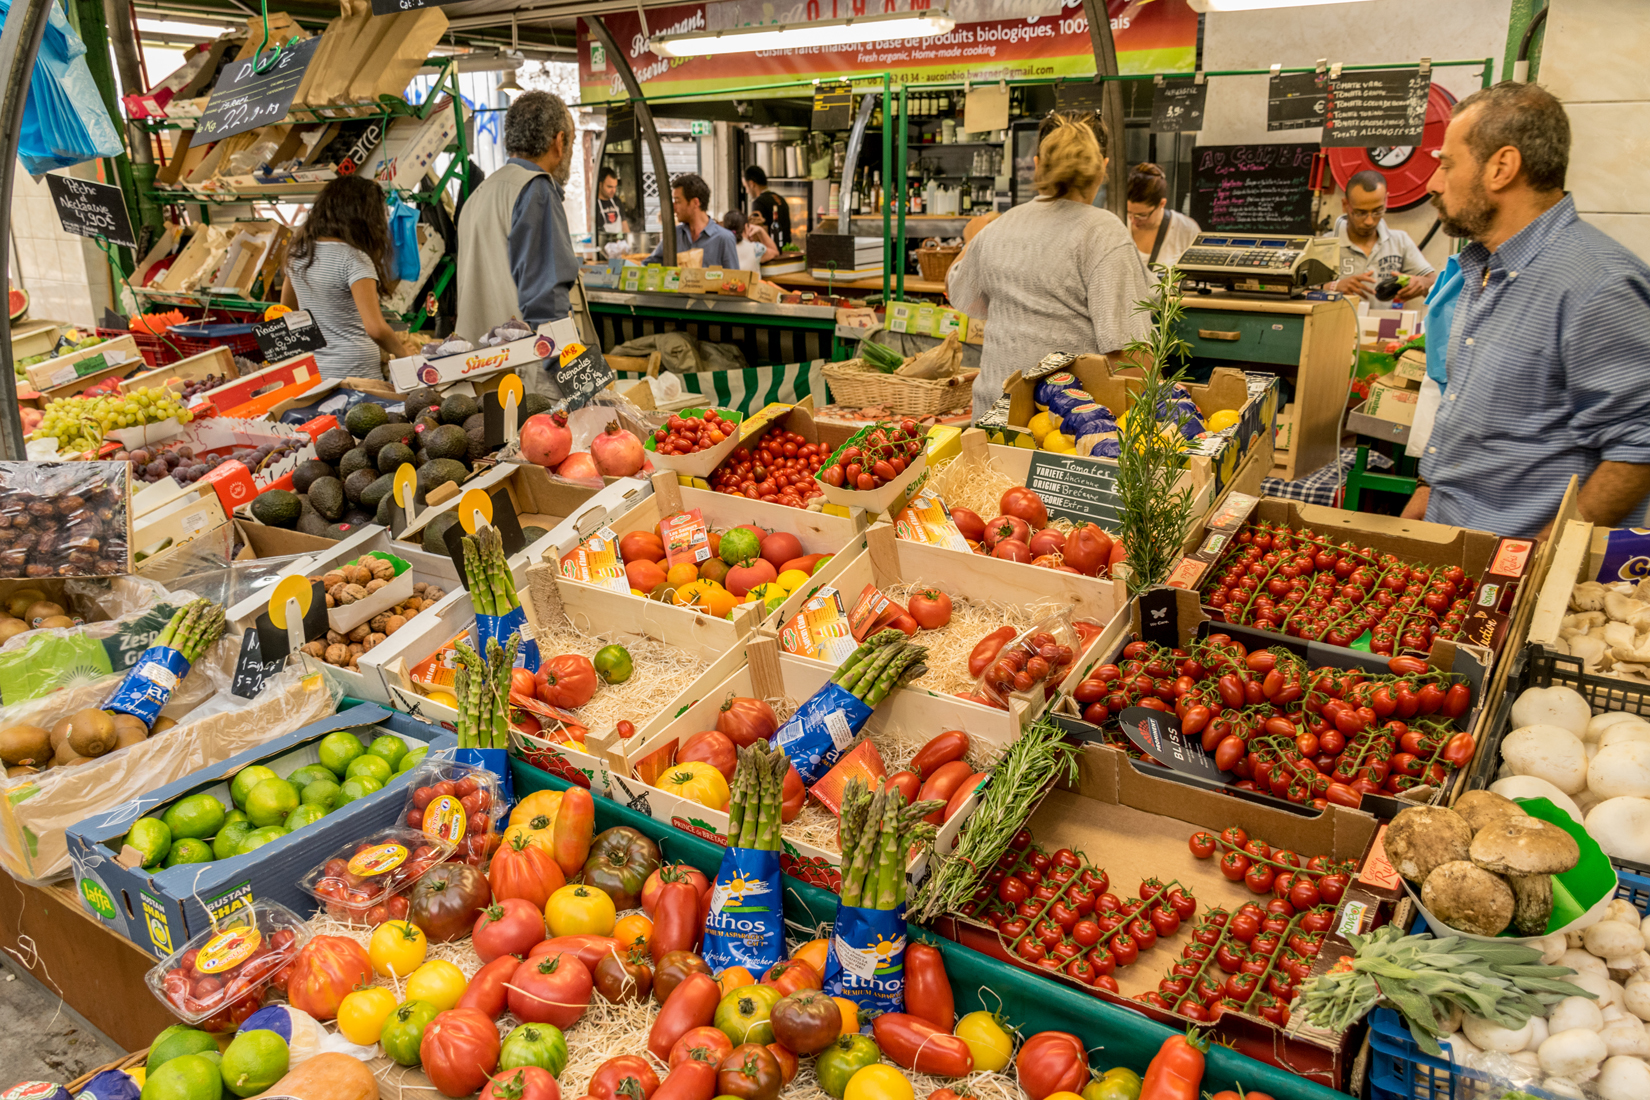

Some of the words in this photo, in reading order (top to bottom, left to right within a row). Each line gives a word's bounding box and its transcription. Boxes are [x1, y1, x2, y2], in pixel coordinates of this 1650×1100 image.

[904, 35, 920, 48] de
[922, 27, 974, 50] produits
[977, 23, 1055, 43] biologiques,
[857, 53, 877, 63] Fresh
[879, 51, 910, 64] organic,
[912, 46, 961, 60] Home-made
[963, 44, 996, 57] cooking
[1313, 101, 1326, 113] €
[461, 348, 510, 374] Sinerji
[1036, 466, 1065, 480] VARIETE
[1064, 473, 1099, 488] Ancienne
[1061, 460, 1111, 478] Tomates
[1032, 479, 1061, 492] ORIGINE
[1061, 485, 1099, 502] Bretagne
[1063, 500, 1090, 512] Extra
[119, 630, 162, 652] Zesp
[1150, 718, 1163, 752] PROMINENT
[1167, 727, 1185, 761] BLISS
[673, 819, 695, 834] PRINCE
[139, 891, 166, 914] BUSTAN
[207, 884, 252, 912] BUSTAN
[142, 902, 168, 925] SHAN
[706, 910, 766, 933] athos
[724, 931, 765, 941] ASPARAGUS
[841, 987, 872, 997] PREMIUM
